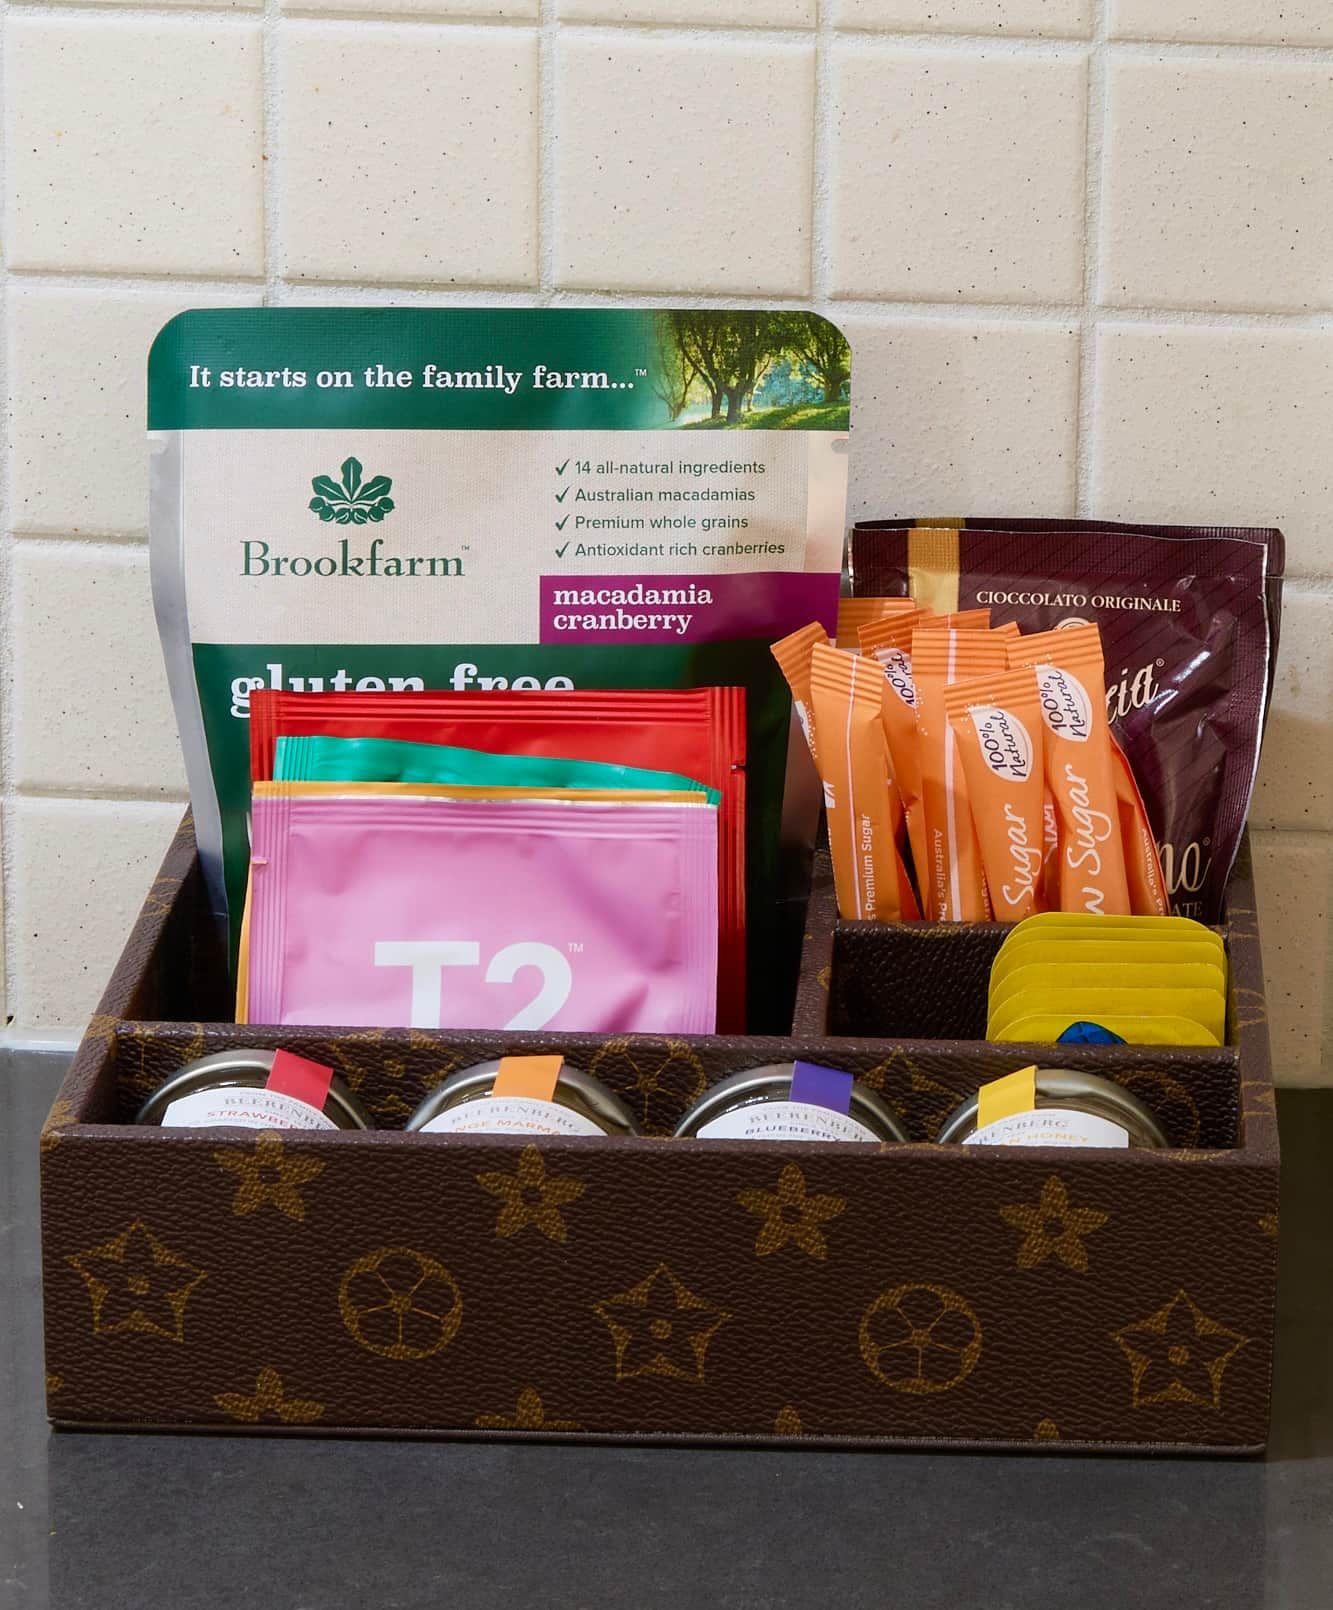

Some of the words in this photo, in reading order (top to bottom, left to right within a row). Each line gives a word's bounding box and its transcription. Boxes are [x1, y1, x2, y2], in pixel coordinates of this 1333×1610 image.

[189, 365, 211, 388] It
[219, 367, 307, 388] starts
[316, 370, 354, 388] on
[364, 364, 413, 388] the
[422, 364, 523, 394] family
[575, 461, 591, 474] 14
[596, 461, 674, 475] all-natural
[679, 460, 766, 477] ingredients
[575, 488, 653, 502] Australian
[658, 487, 756, 501] macadamias
[575, 515, 645, 529] Premium
[650, 515, 697, 529] whole
[701, 515, 749, 532] grains
[575, 543, 664, 557] Antioxidant
[669, 542, 697, 556] rich
[702, 541, 785, 557] cranberries
[553, 584, 713, 605] macadamia
[976, 591, 1087, 608] CIOCCOLATO
[1091, 595, 1182, 612] ORIGINALE
[553, 609, 693, 635] cranberry
[1040, 681, 1067, 731] 100%
[1048, 670, 1088, 738] Natural
[979, 721, 1008, 772] 100%
[989, 710, 1028, 778] Natural
[861, 813, 873, 852] Sugar
[1065, 763, 1112, 876] Sugar
[1002, 803, 1043, 905] Sugar
[863, 854, 876, 912] Premium
